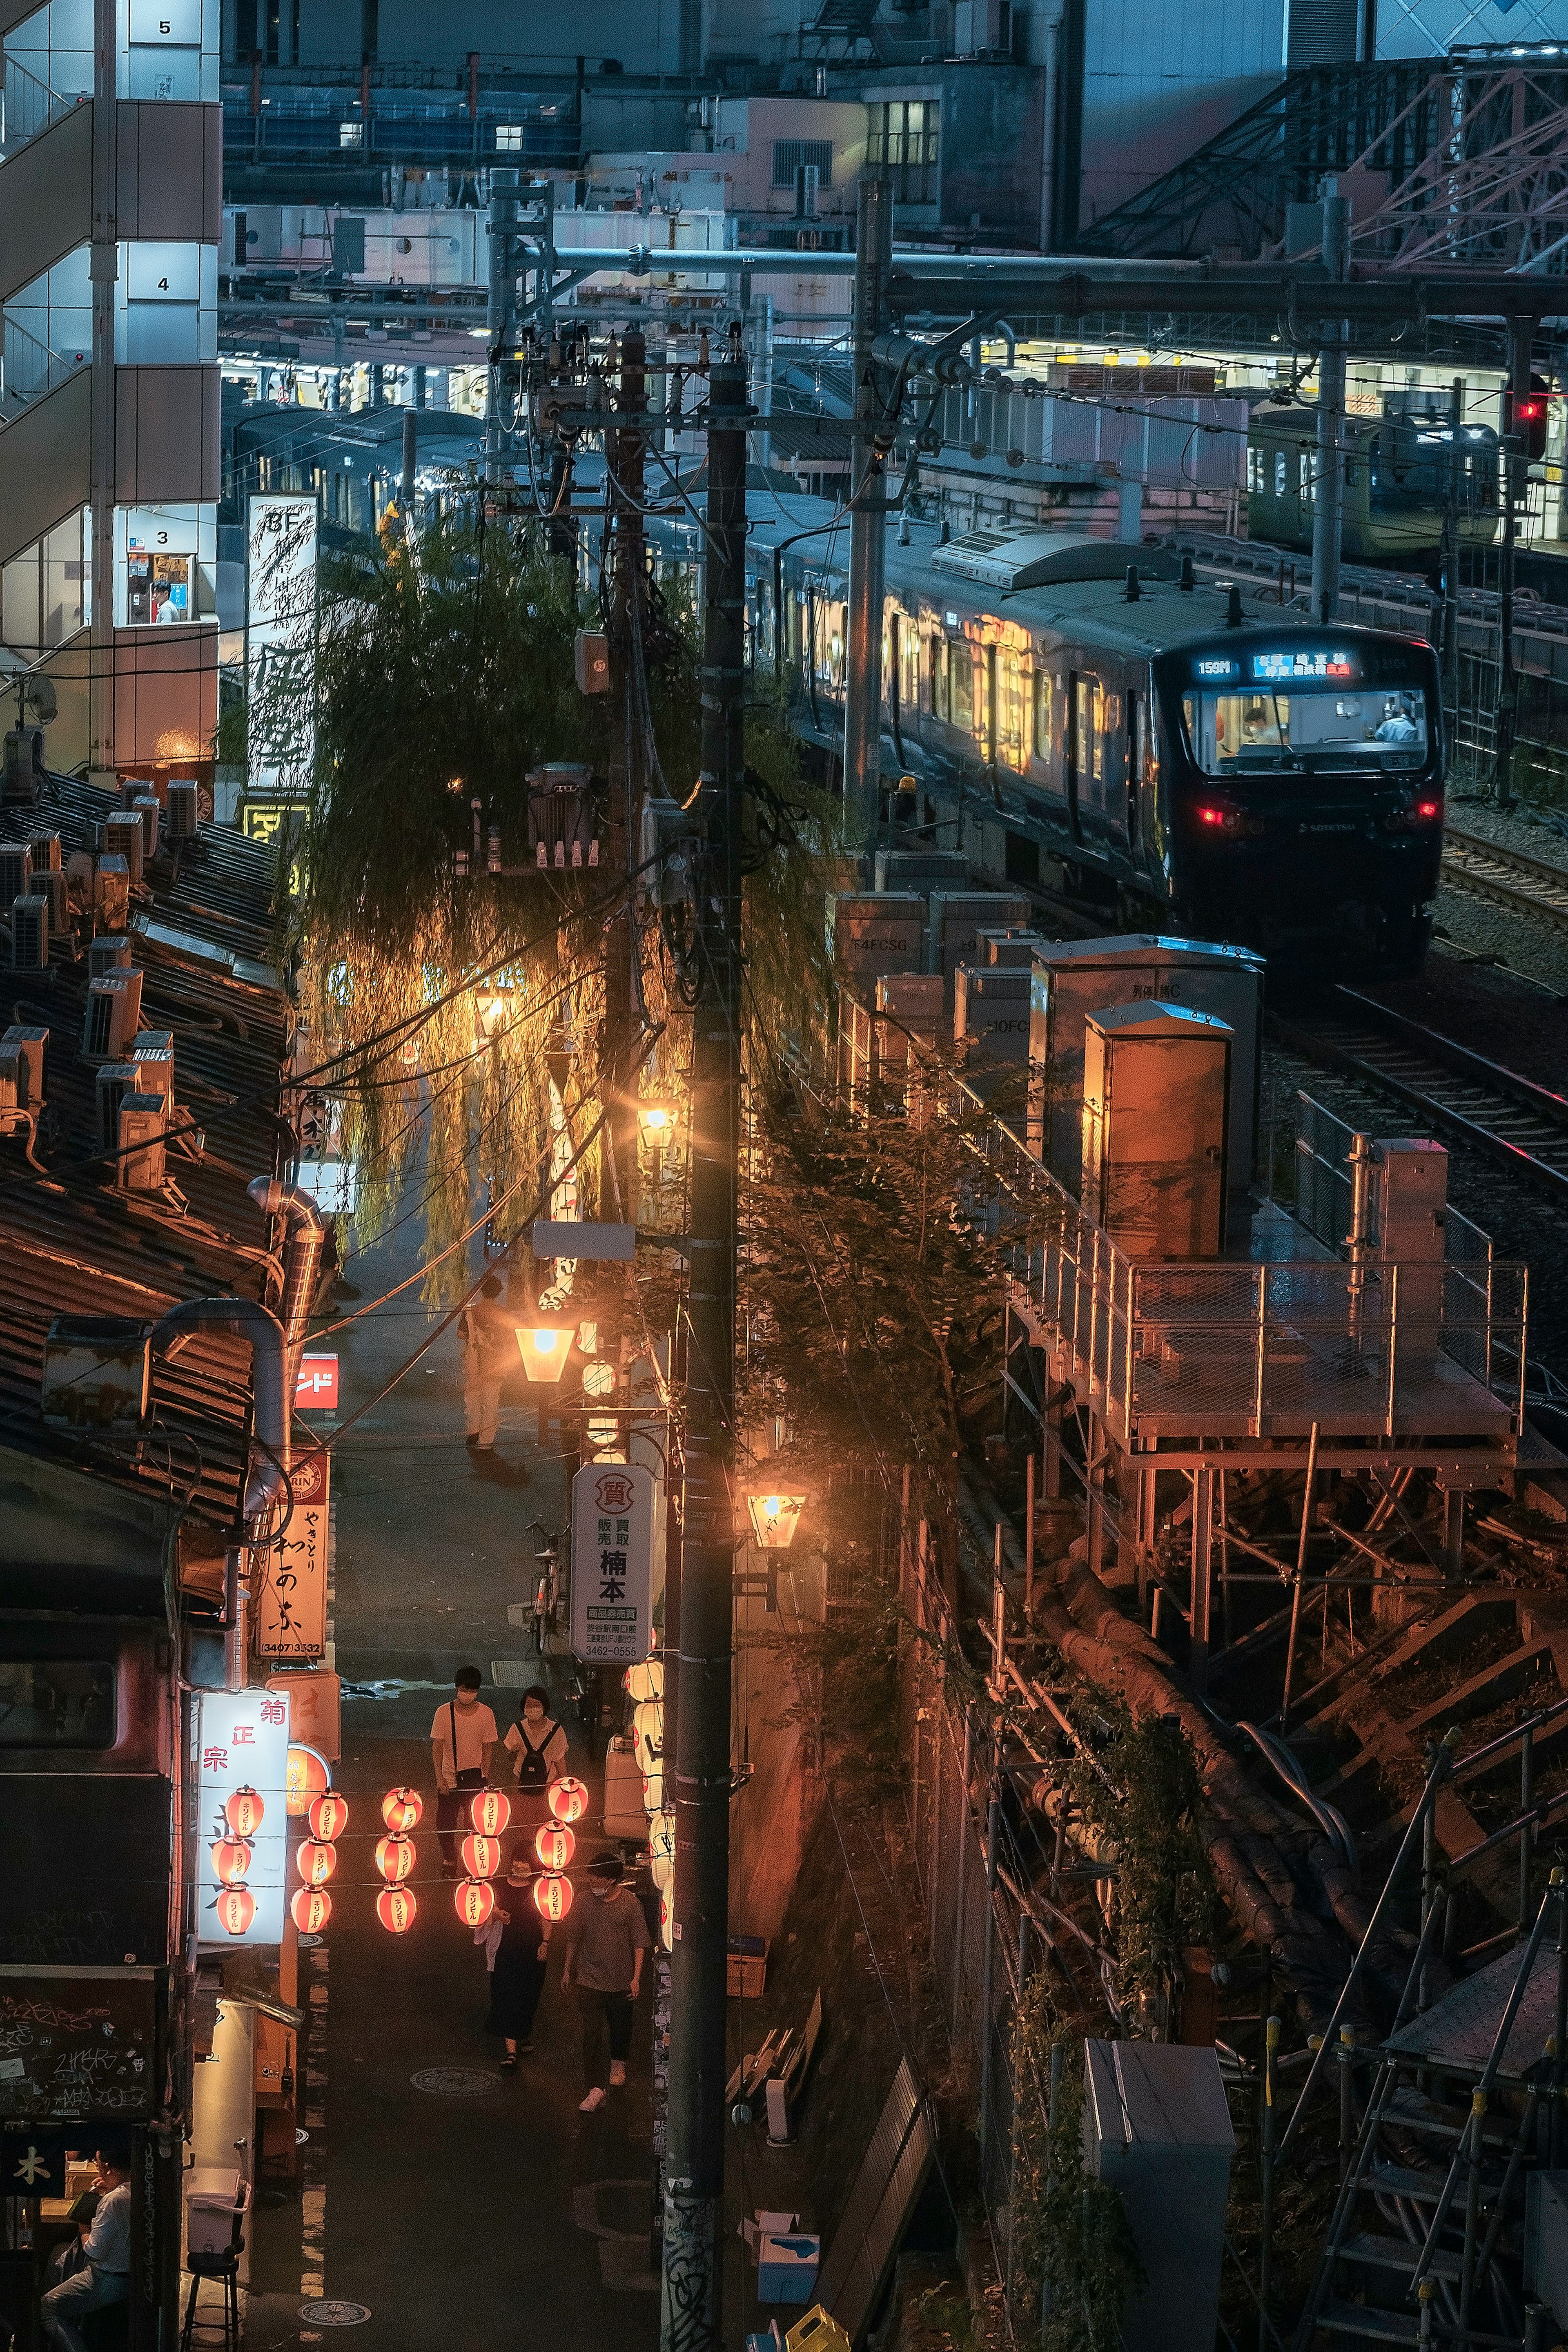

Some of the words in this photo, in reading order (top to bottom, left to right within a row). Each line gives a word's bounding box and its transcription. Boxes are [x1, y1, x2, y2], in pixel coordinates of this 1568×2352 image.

[159, 21, 170, 34] 5
[158, 277, 169, 291] 4
[157, 531, 168, 544] 3
[1198, 662, 1231, 674] 159M
[291, 1478, 310, 1486] RIN
[604, 1481, 626, 1505] 質
[305, 1512, 319, 1572] やきとり
[598, 1519, 611, 1545] 販売
[616, 1519, 629, 1546] 買取
[599, 1550, 627, 1603] 楠本
[588, 1608, 636, 1619] 商品券売買
[586, 1624, 636, 1633] 渋谷駅南口前
[586, 1646, 636, 1656] 3462-0555
[323, 1805, 332, 1835] キリンビール
[477, 1839, 487, 1869] キリンビール
[311, 1900, 321, 1928] キリンビール
[395, 1899, 403, 1927] キリンビール
